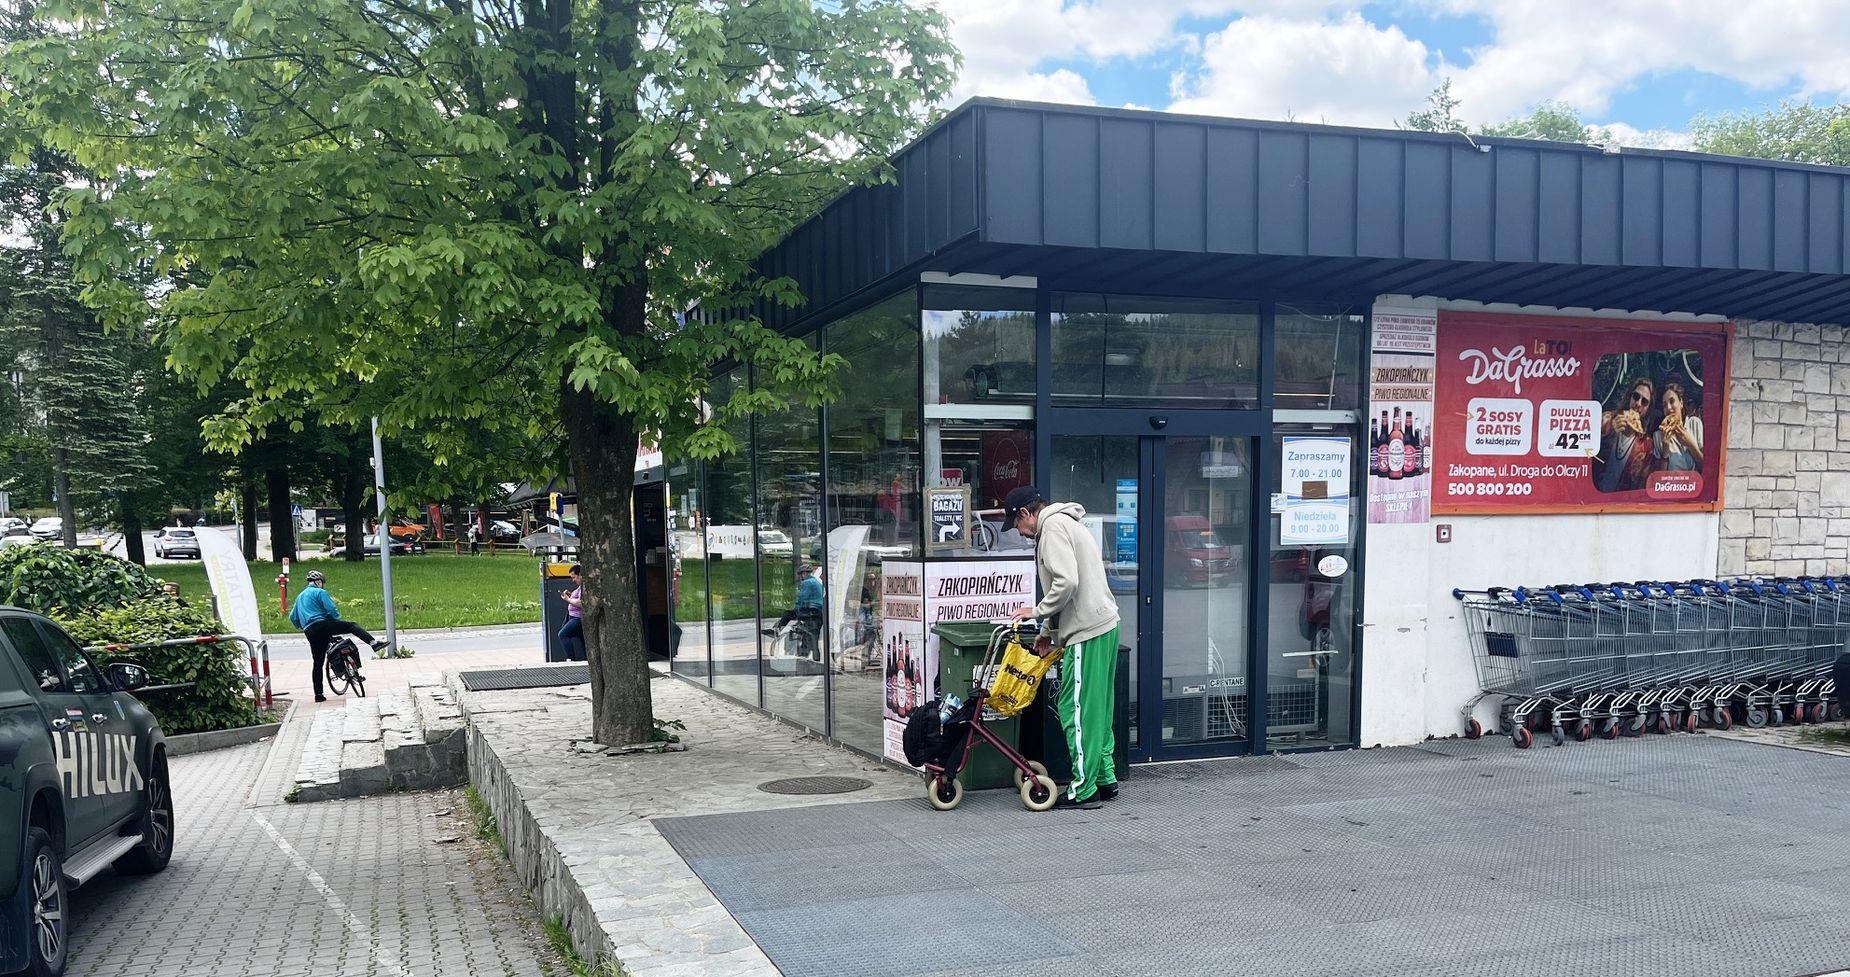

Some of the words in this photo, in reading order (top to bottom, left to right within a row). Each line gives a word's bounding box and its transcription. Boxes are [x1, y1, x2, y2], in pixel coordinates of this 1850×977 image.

[1376, 364, 1429, 382] ZAKOPIAŃCZYK
[1459, 344, 1581, 394] DaGrasso
[1374, 388, 1391, 399] PIWO
[1392, 388, 1429, 400] REGIONALNE
[1476, 407, 1486, 422] 2
[1490, 412, 1523, 422] SOSY
[1551, 406, 1591, 418] DUUUŻA
[1476, 425, 1521, 436] GRATIS
[1550, 419, 1591, 431] PIZZA
[1485, 437, 1504, 446] każdej
[1555, 433, 1579, 449] 42
[1288, 451, 1345, 463] Zapraszamy
[1290, 469, 1310, 478] 7.00
[1319, 469, 1342, 478] 21.00
[1448, 464, 1496, 478] Zakopane,
[1498, 464, 1509, 476] ul.
[1510, 465, 1540, 479] Droga
[1541, 465, 1554, 476] do
[1555, 465, 1580, 478] Olczy
[1448, 483, 1474, 495] 500
[1476, 483, 1504, 495] 800
[1506, 483, 1532, 495] 200
[1655, 482, 1696, 493] DaGrasso.pl
[1294, 512, 1336, 520] Niedziela
[1291, 525, 1308, 533] 9.00
[1317, 524, 1339, 532] 20.00
[938, 572, 1023, 596] ZAKOPIAŃCZYK
[937, 605, 963, 620] PIWO
[52, 732, 143, 798] HILUX
